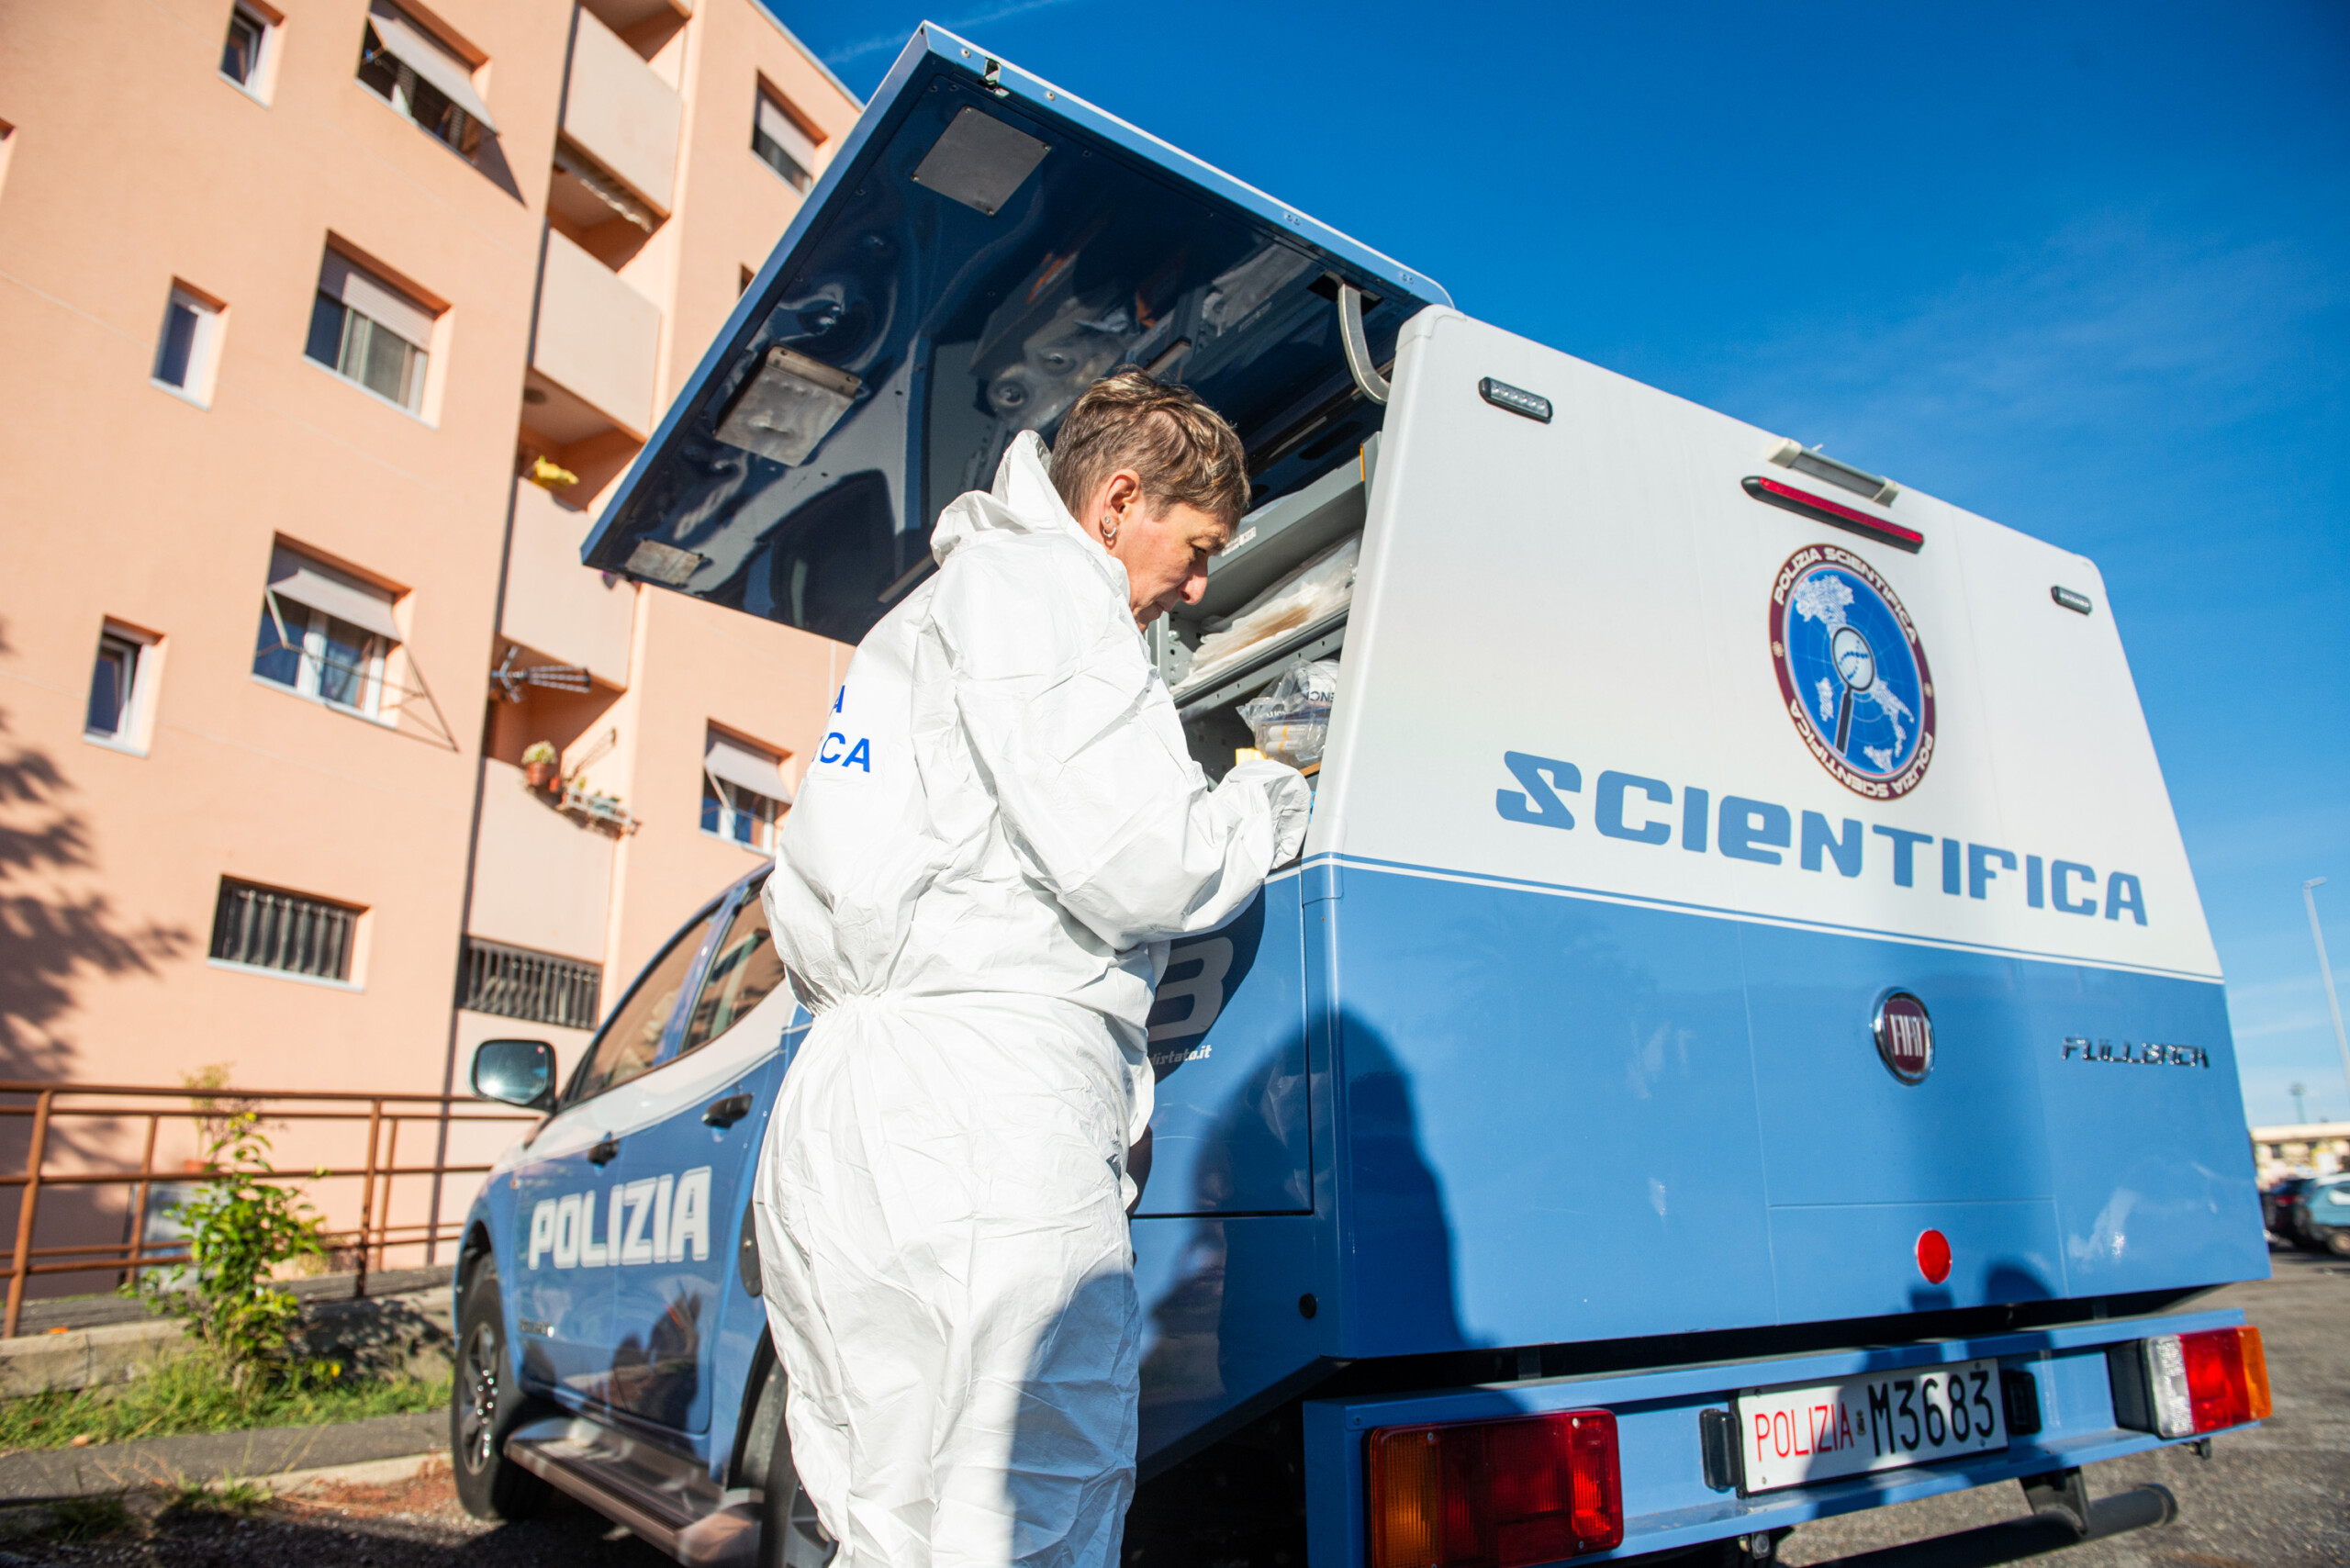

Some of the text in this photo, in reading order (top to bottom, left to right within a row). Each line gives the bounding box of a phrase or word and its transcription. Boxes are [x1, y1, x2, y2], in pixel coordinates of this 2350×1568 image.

[1774, 547, 1918, 644] POLIZIA SCIENTIFICA
[816, 732, 871, 773] CA
[1789, 699, 1934, 798] POLIZIA SCIENTIFICA
[1889, 1014, 1924, 1057] FIAT
[528, 1165, 712, 1271] POLIZIA
[1754, 1371, 1996, 1462] POLIZIA M3683
